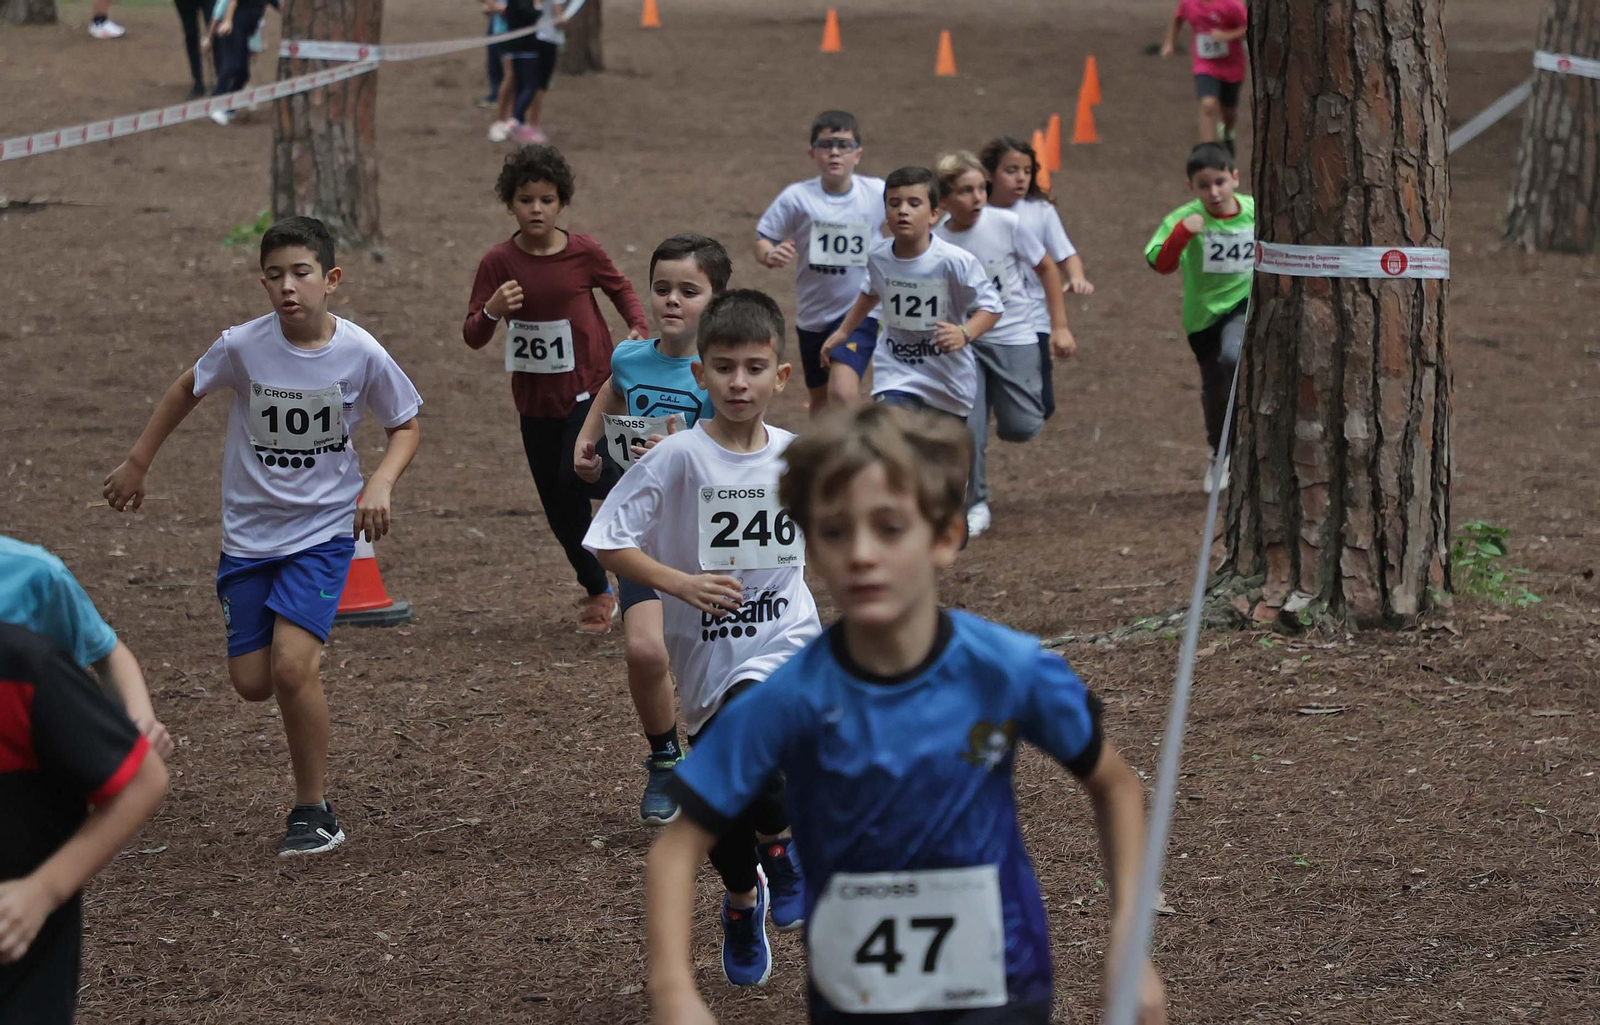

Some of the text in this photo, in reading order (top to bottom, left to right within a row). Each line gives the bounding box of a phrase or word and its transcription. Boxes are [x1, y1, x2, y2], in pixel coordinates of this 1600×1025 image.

[818, 234, 863, 254] 103
[1210, 242, 1254, 261] 242
[1316, 254, 1340, 262] Deportes
[891, 280, 918, 290] CROSS
[890, 294, 938, 318] 121
[514, 322, 540, 332] CROSS
[513, 336, 565, 360] 261
[263, 388, 303, 400] CROSS
[261, 405, 331, 435] 101
[612, 418, 645, 429] CROSS
[717, 488, 766, 500] CROSS
[709, 506, 796, 549] 246
[839, 883, 918, 899] CROSS
[855, 916, 956, 975] 47
